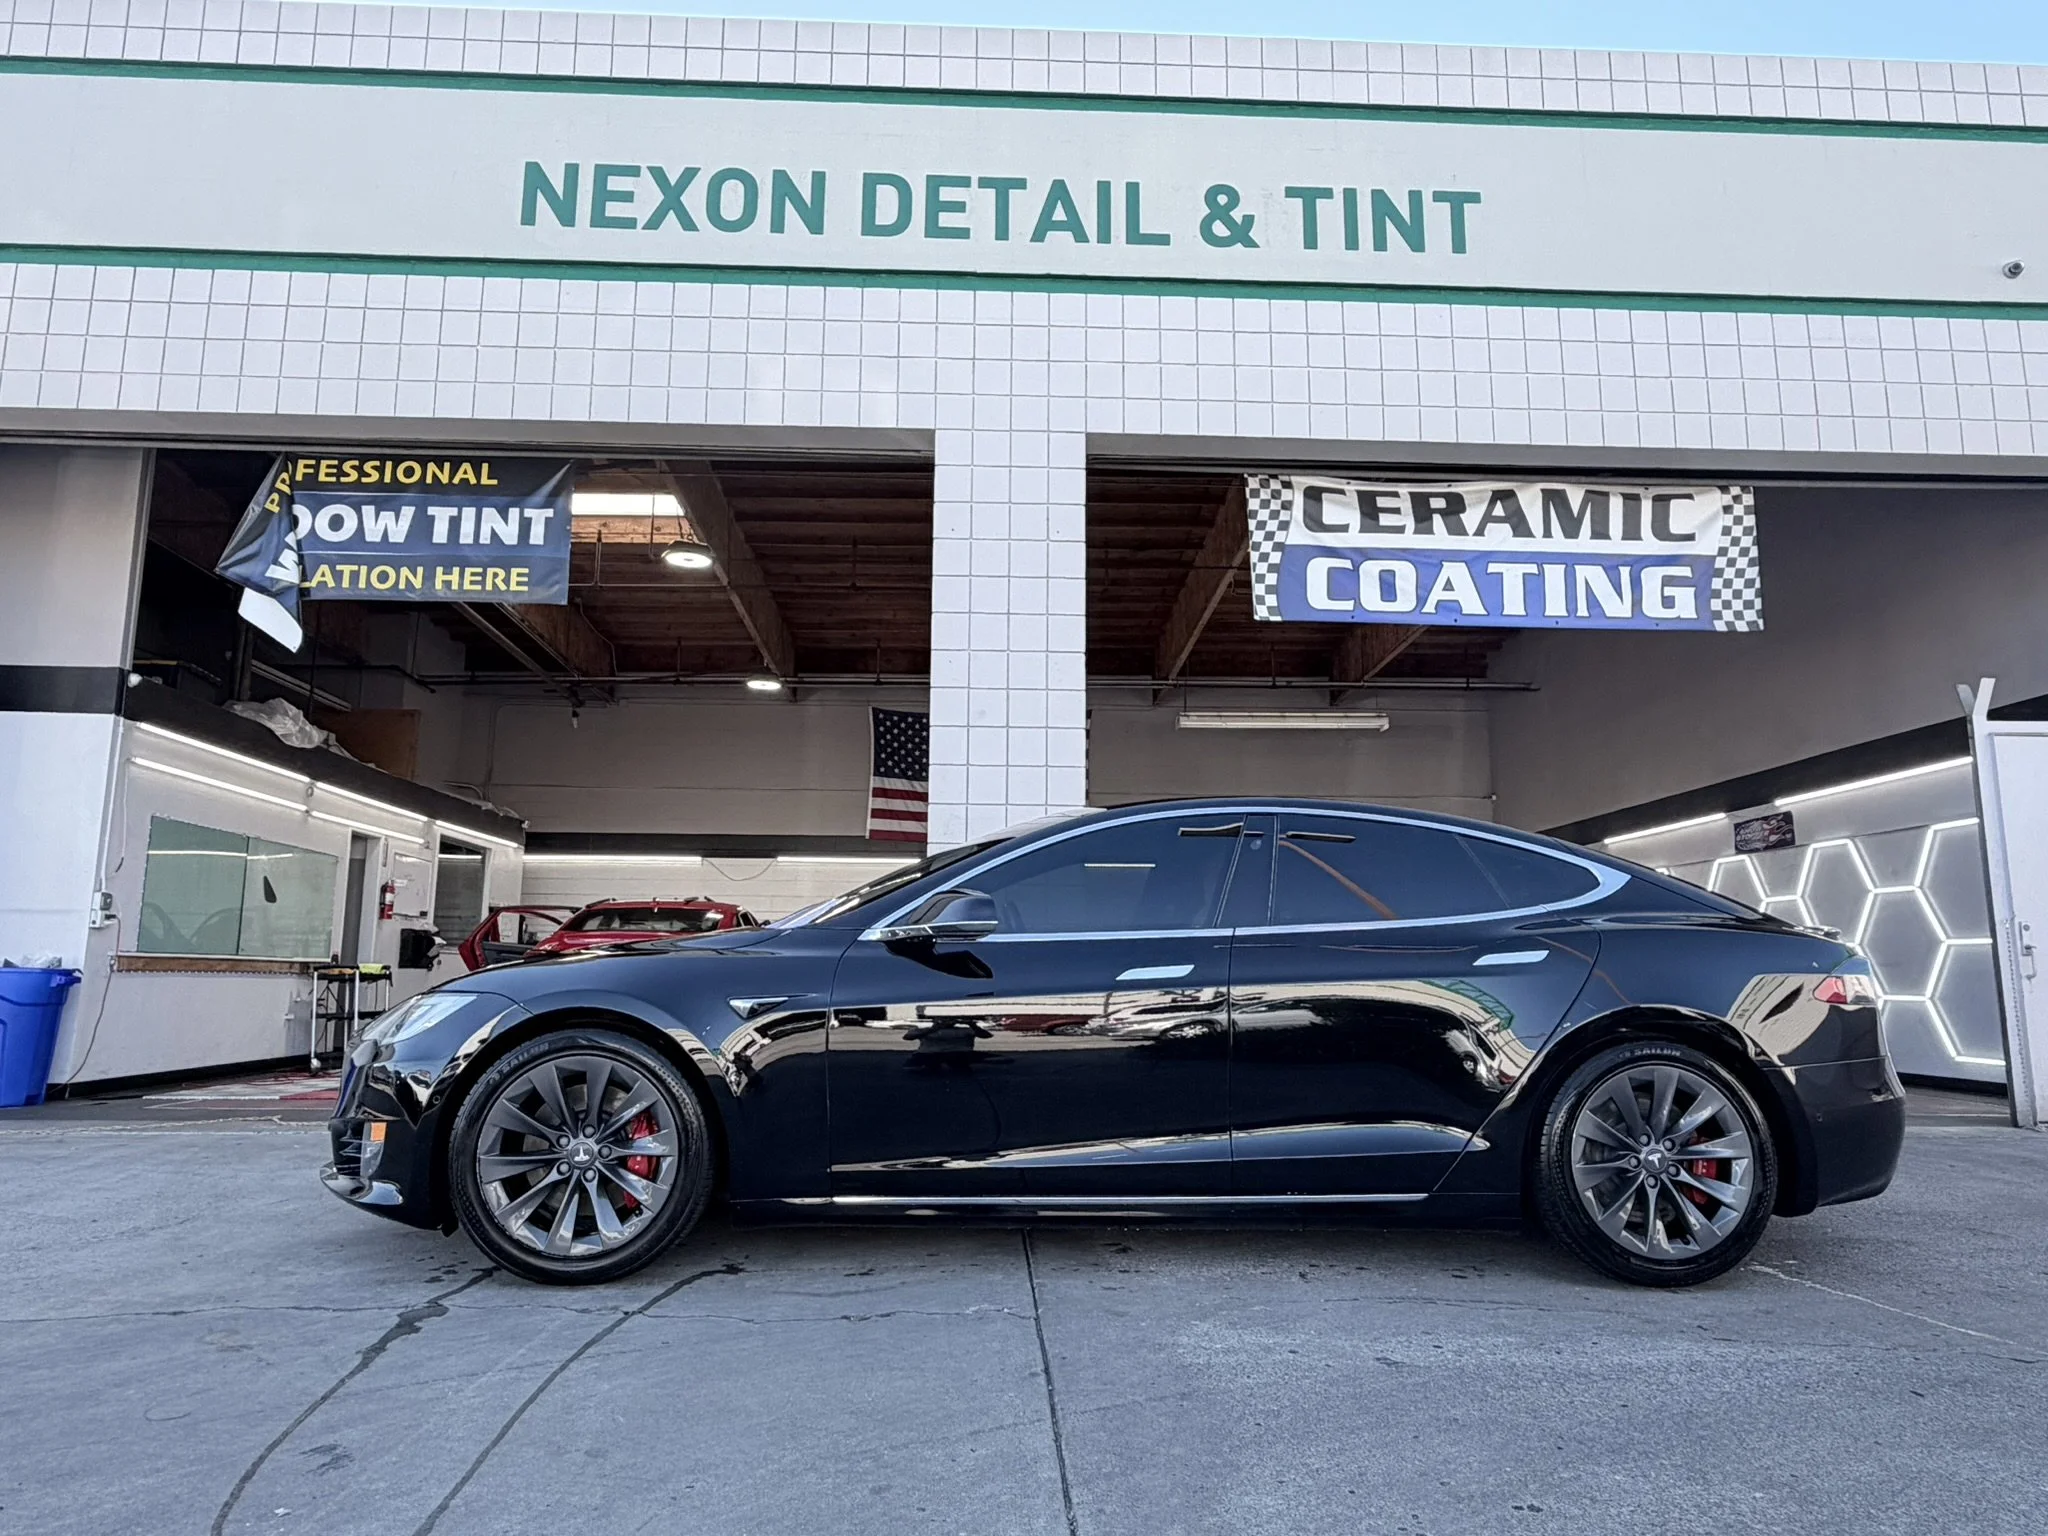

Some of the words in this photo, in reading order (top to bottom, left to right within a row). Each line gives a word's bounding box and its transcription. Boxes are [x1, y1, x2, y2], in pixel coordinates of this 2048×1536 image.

[520, 161, 826, 235] NEXON
[862, 173, 1170, 247] DETAIL
[1200, 184, 1259, 249] &
[1285, 187, 1482, 254] TINT
[427, 506, 554, 545] TINT
[1302, 485, 1698, 542] CERAMIC
[434, 566, 530, 592] HERE
[1305, 555, 1699, 620] COATING
